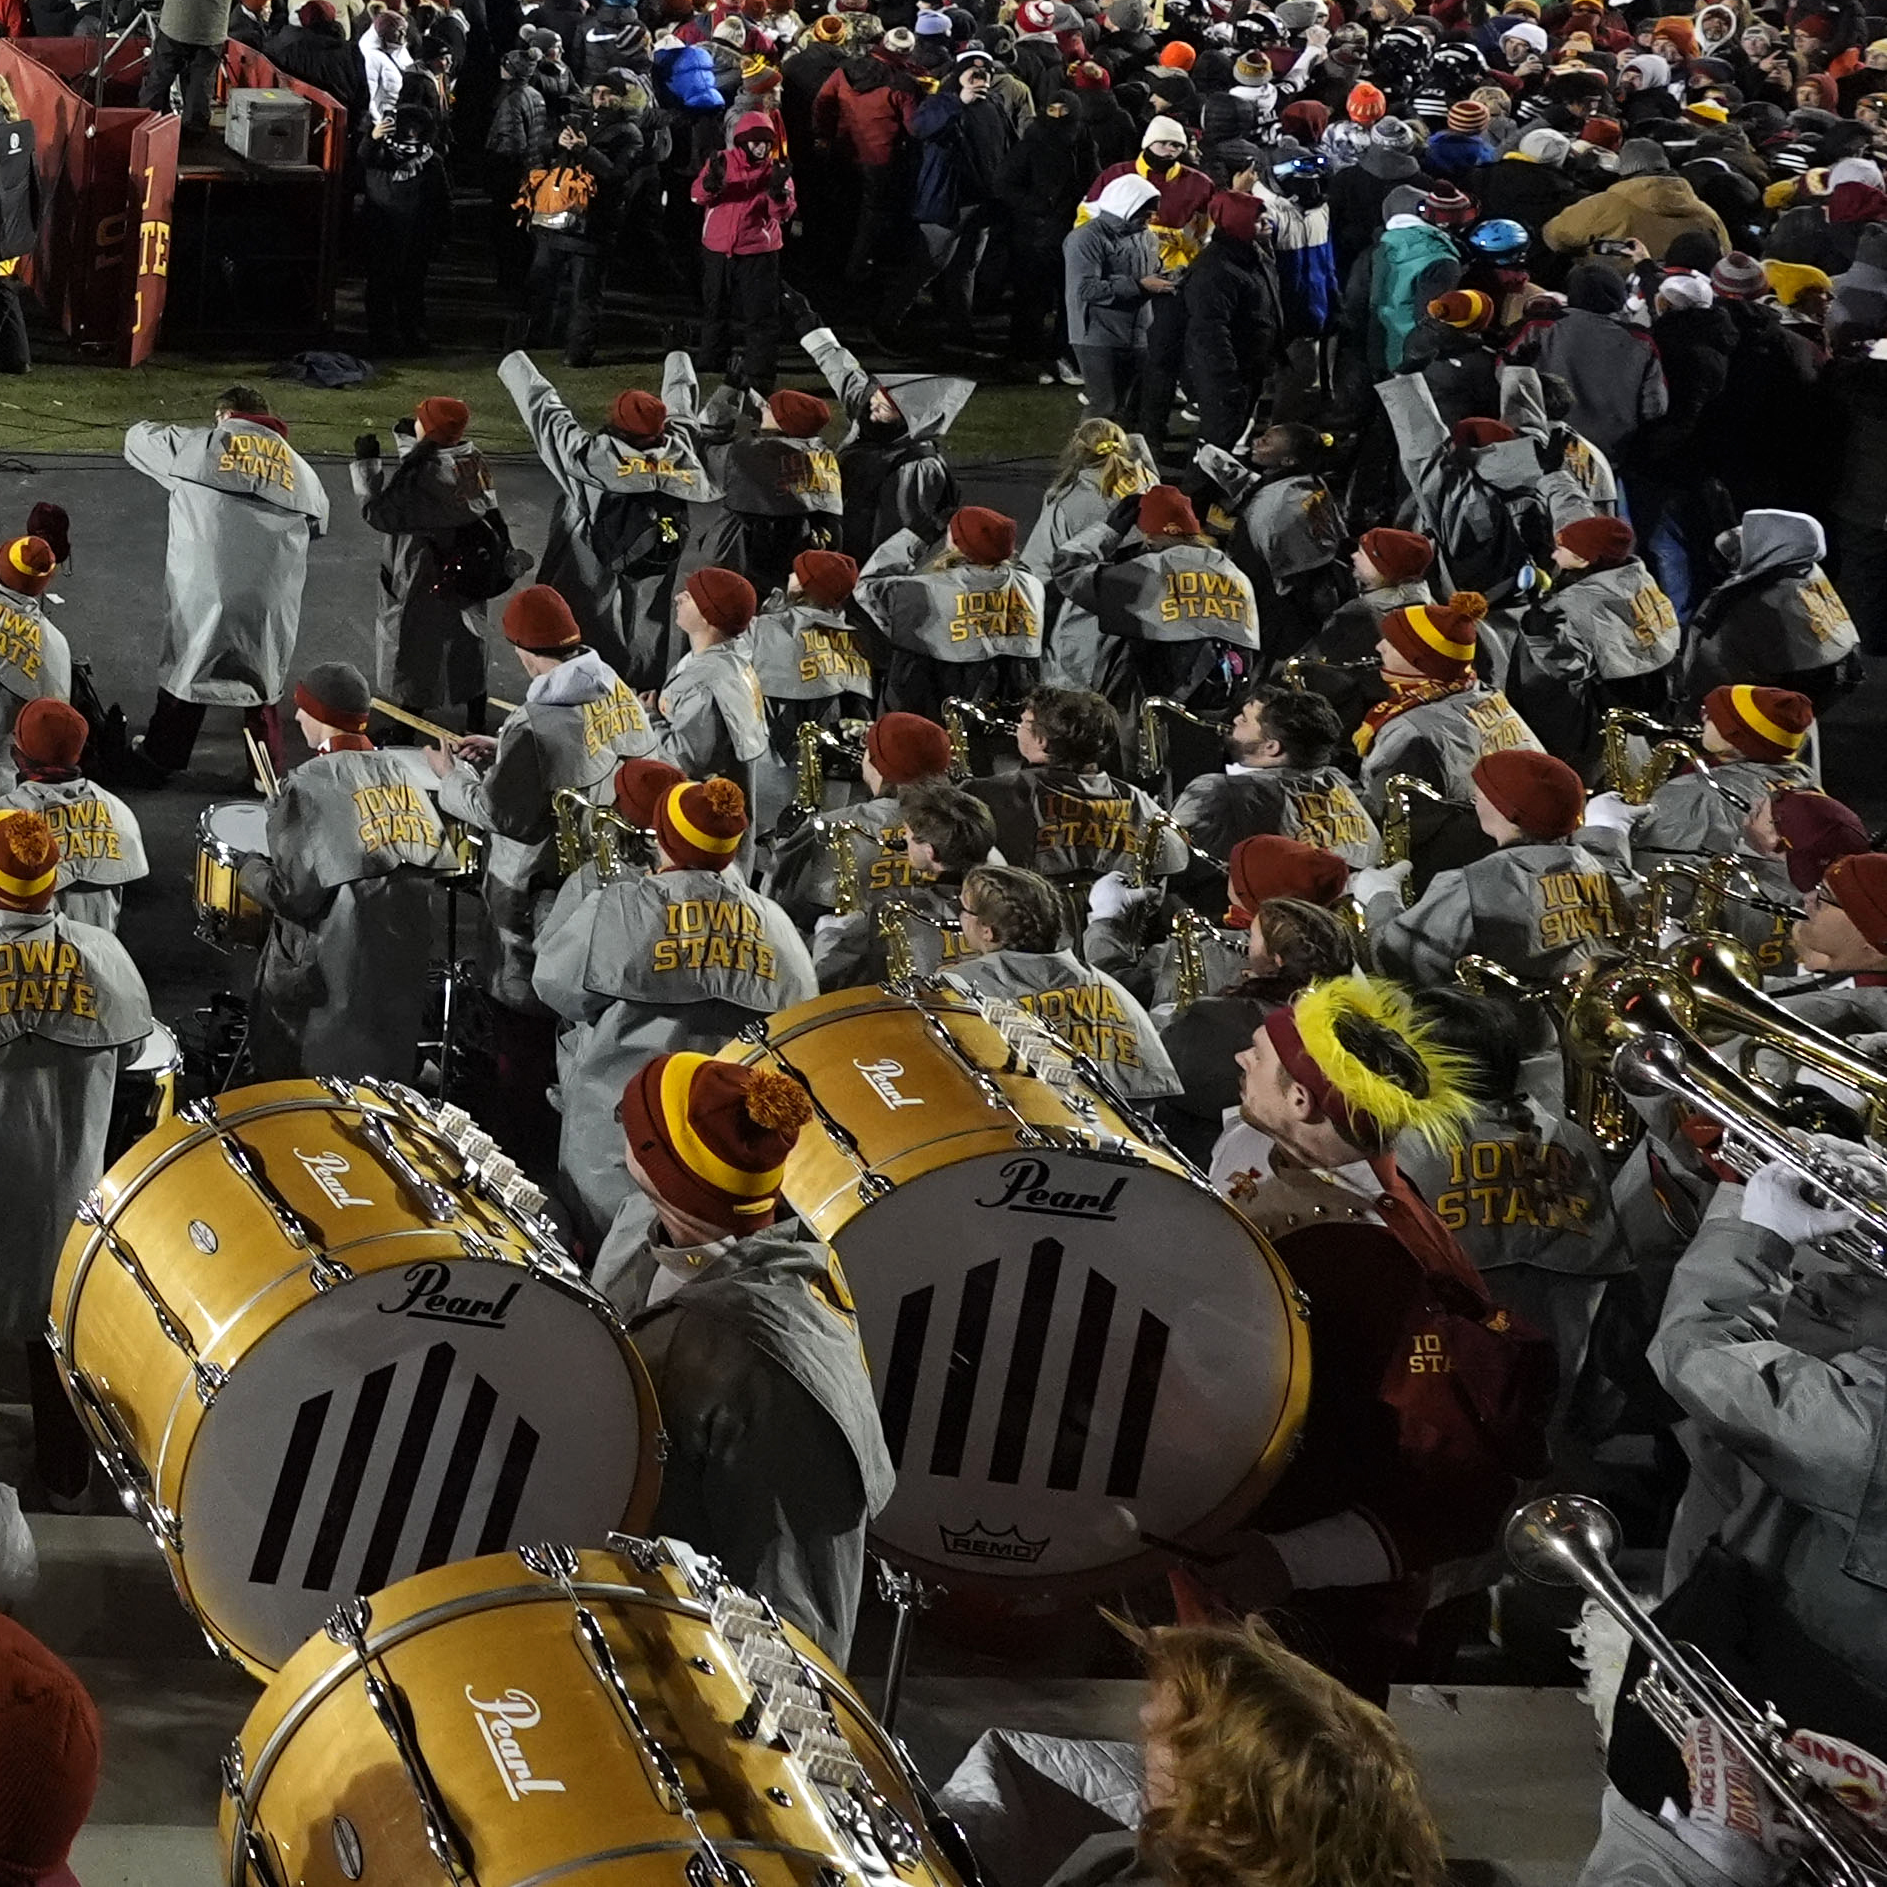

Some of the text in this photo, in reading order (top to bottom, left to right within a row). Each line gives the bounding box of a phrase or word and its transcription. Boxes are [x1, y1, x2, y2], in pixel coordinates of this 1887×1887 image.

[216, 449, 295, 494] STATE
[228, 433, 293, 465] IOWA
[584, 708, 648, 761] STATE
[353, 782, 426, 816] IOWA
[46, 827, 121, 863] TATE
[357, 810, 443, 853] STATE
[1538, 871, 1614, 910] IOW
[665, 903, 766, 942] IOWA
[1540, 907, 1614, 948] STAT
[652, 936, 777, 982] STATE
[1054, 1021, 1141, 1070] TATE
[853, 1056, 926, 1111] Pearl
[292, 1145, 376, 1209] Pearl
[1448, 1139, 1576, 1188] IOWA
[975, 1157, 1130, 1221] Pearl
[1436, 1183, 1596, 1235] STATE
[377, 1262, 524, 1331] Pearl
[952, 1537, 1034, 1559] REMO
[467, 1683, 569, 1803] Pearl
